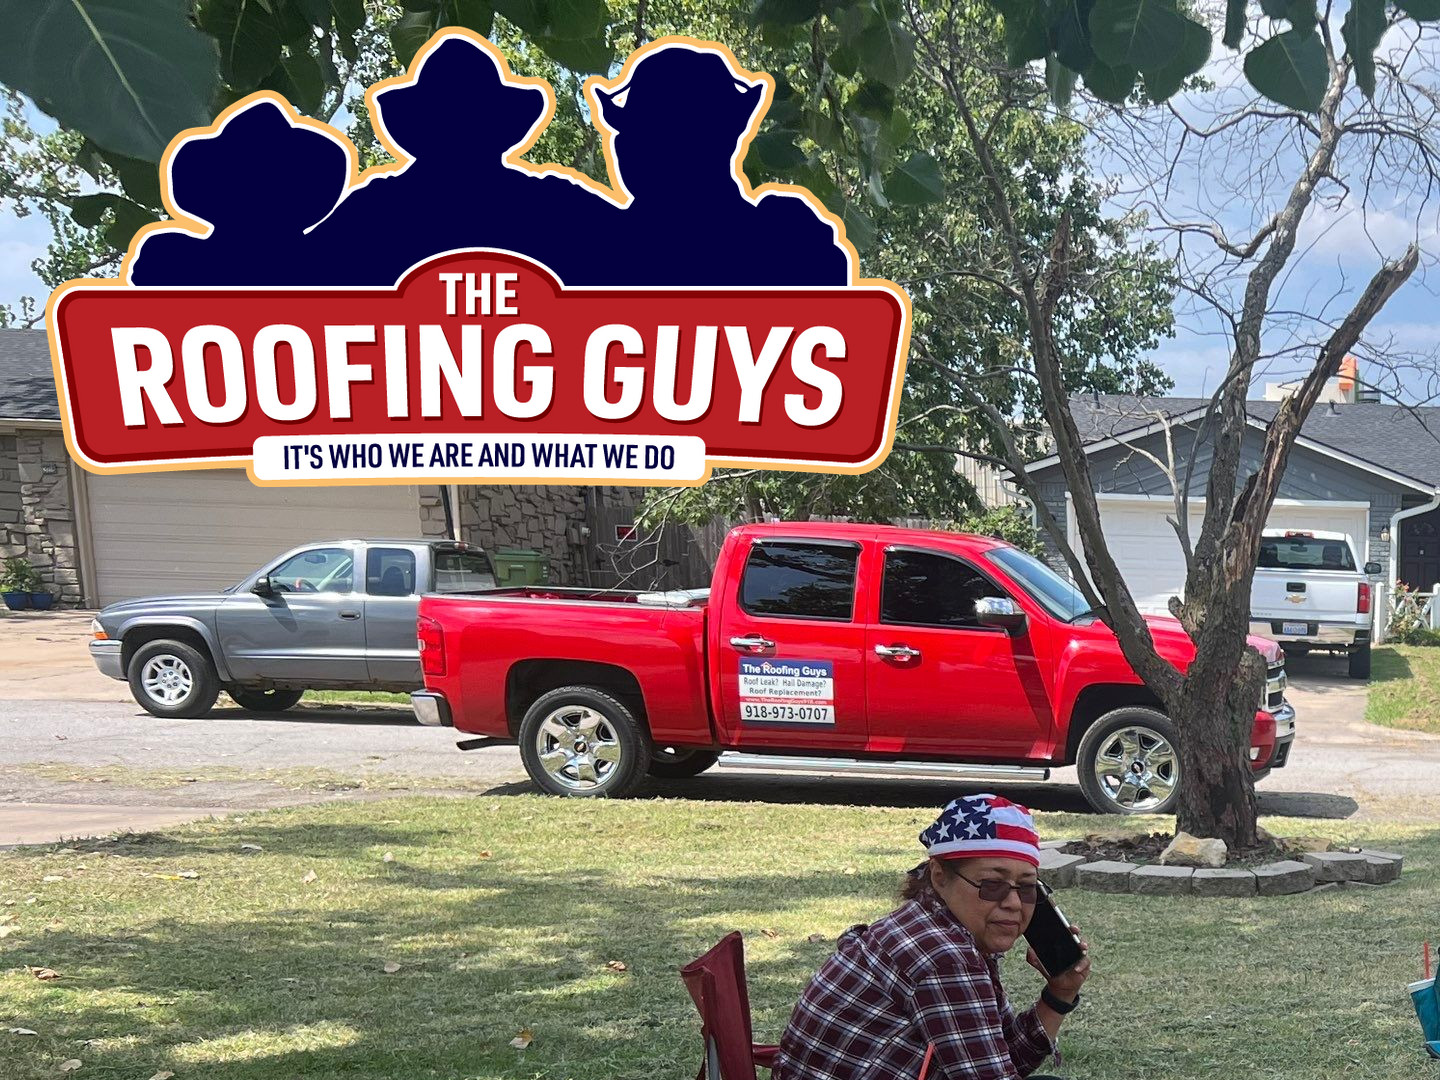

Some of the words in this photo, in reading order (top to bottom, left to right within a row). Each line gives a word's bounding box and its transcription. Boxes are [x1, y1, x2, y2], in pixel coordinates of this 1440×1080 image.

[742, 663, 761, 674] The
[763, 665, 800, 677] Roofing
[802, 666, 827, 678] Guys
[743, 677, 759, 686] Roof
[760, 678, 778, 686] Leak?
[782, 679, 795, 687] Hail
[797, 680, 827, 690] Damage?
[749, 687, 767, 695] Roof
[768, 688, 822, 697] Replacement?
[745, 705, 828, 721] 918-973-0707
